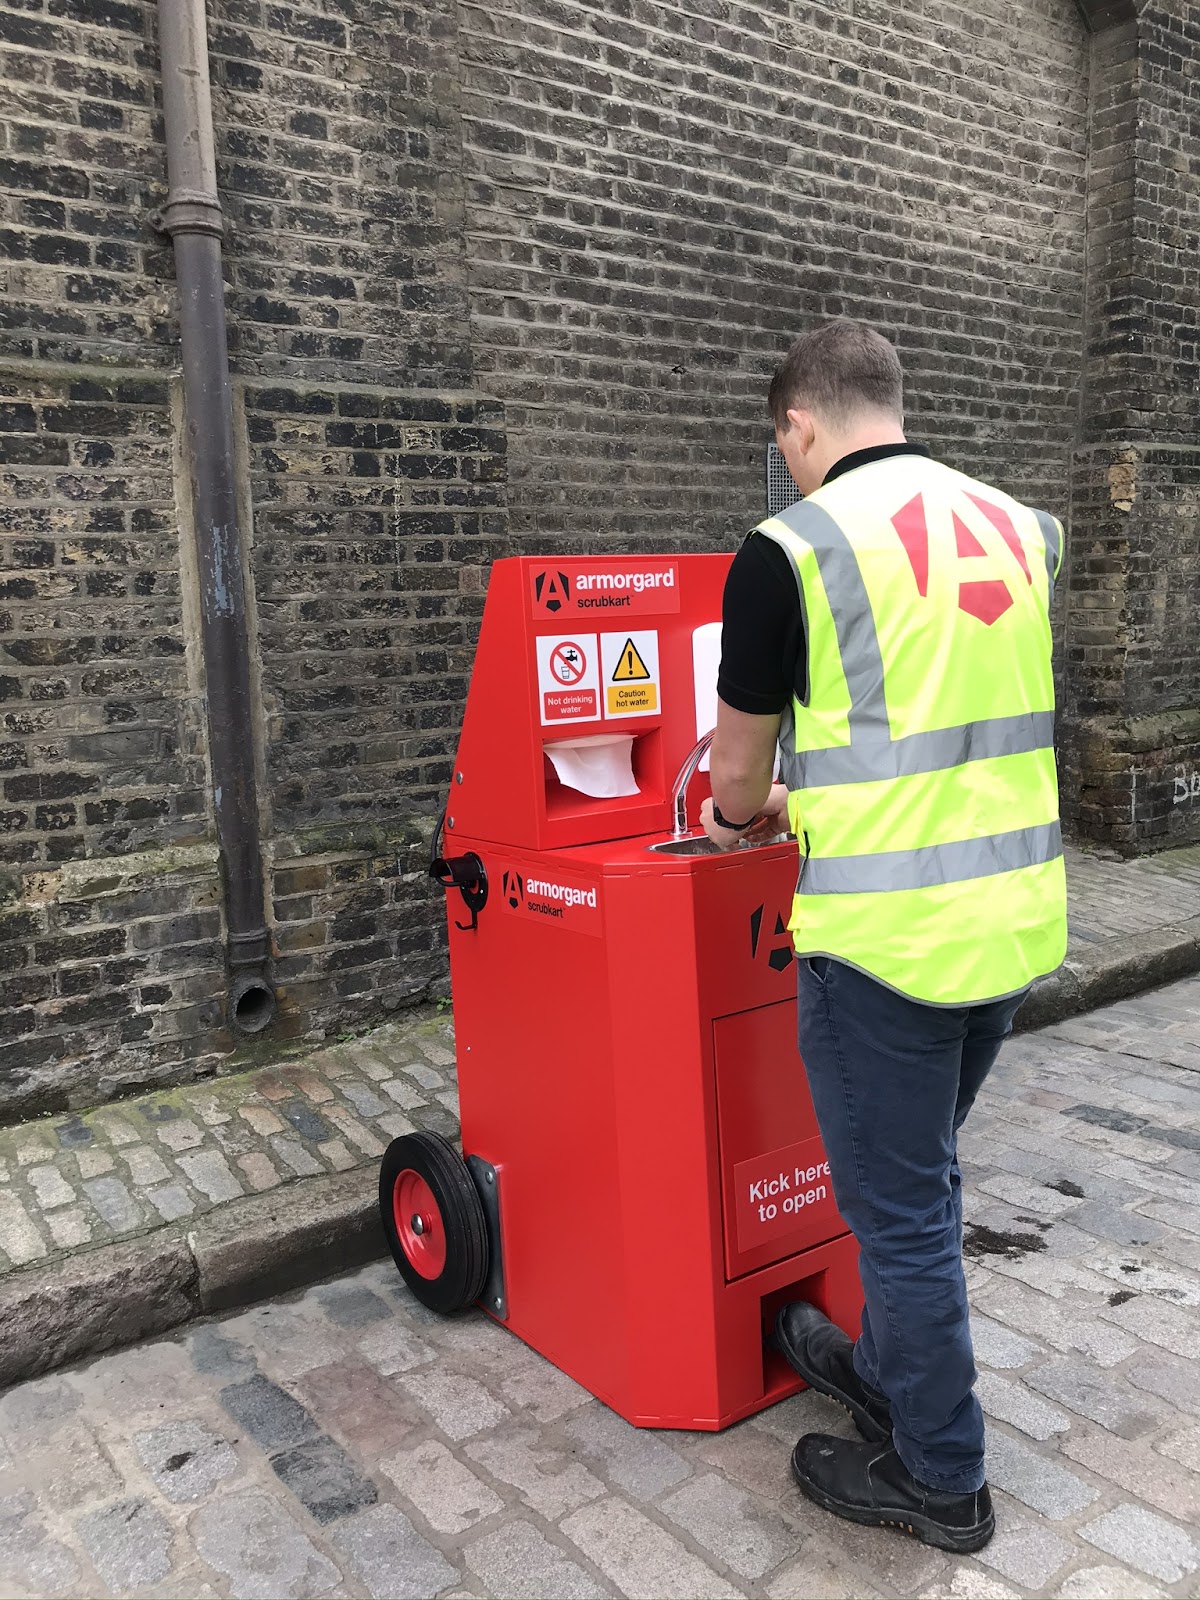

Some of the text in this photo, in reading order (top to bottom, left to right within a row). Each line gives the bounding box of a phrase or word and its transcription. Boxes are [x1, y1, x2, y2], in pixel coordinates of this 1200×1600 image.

[576, 568, 674, 592] armorgard
[577, 595, 631, 608] scrubkart
[547, 695, 593, 706] Not drinking
[618, 689, 646, 698] Caution
[630, 698, 649, 706] water
[560, 706, 582, 714] water
[526, 878, 597, 908] armorgard
[528, 901, 564, 918] scrubkart
[749, 1161, 831, 1203] Kick here
[758, 1185, 827, 1222] to open
